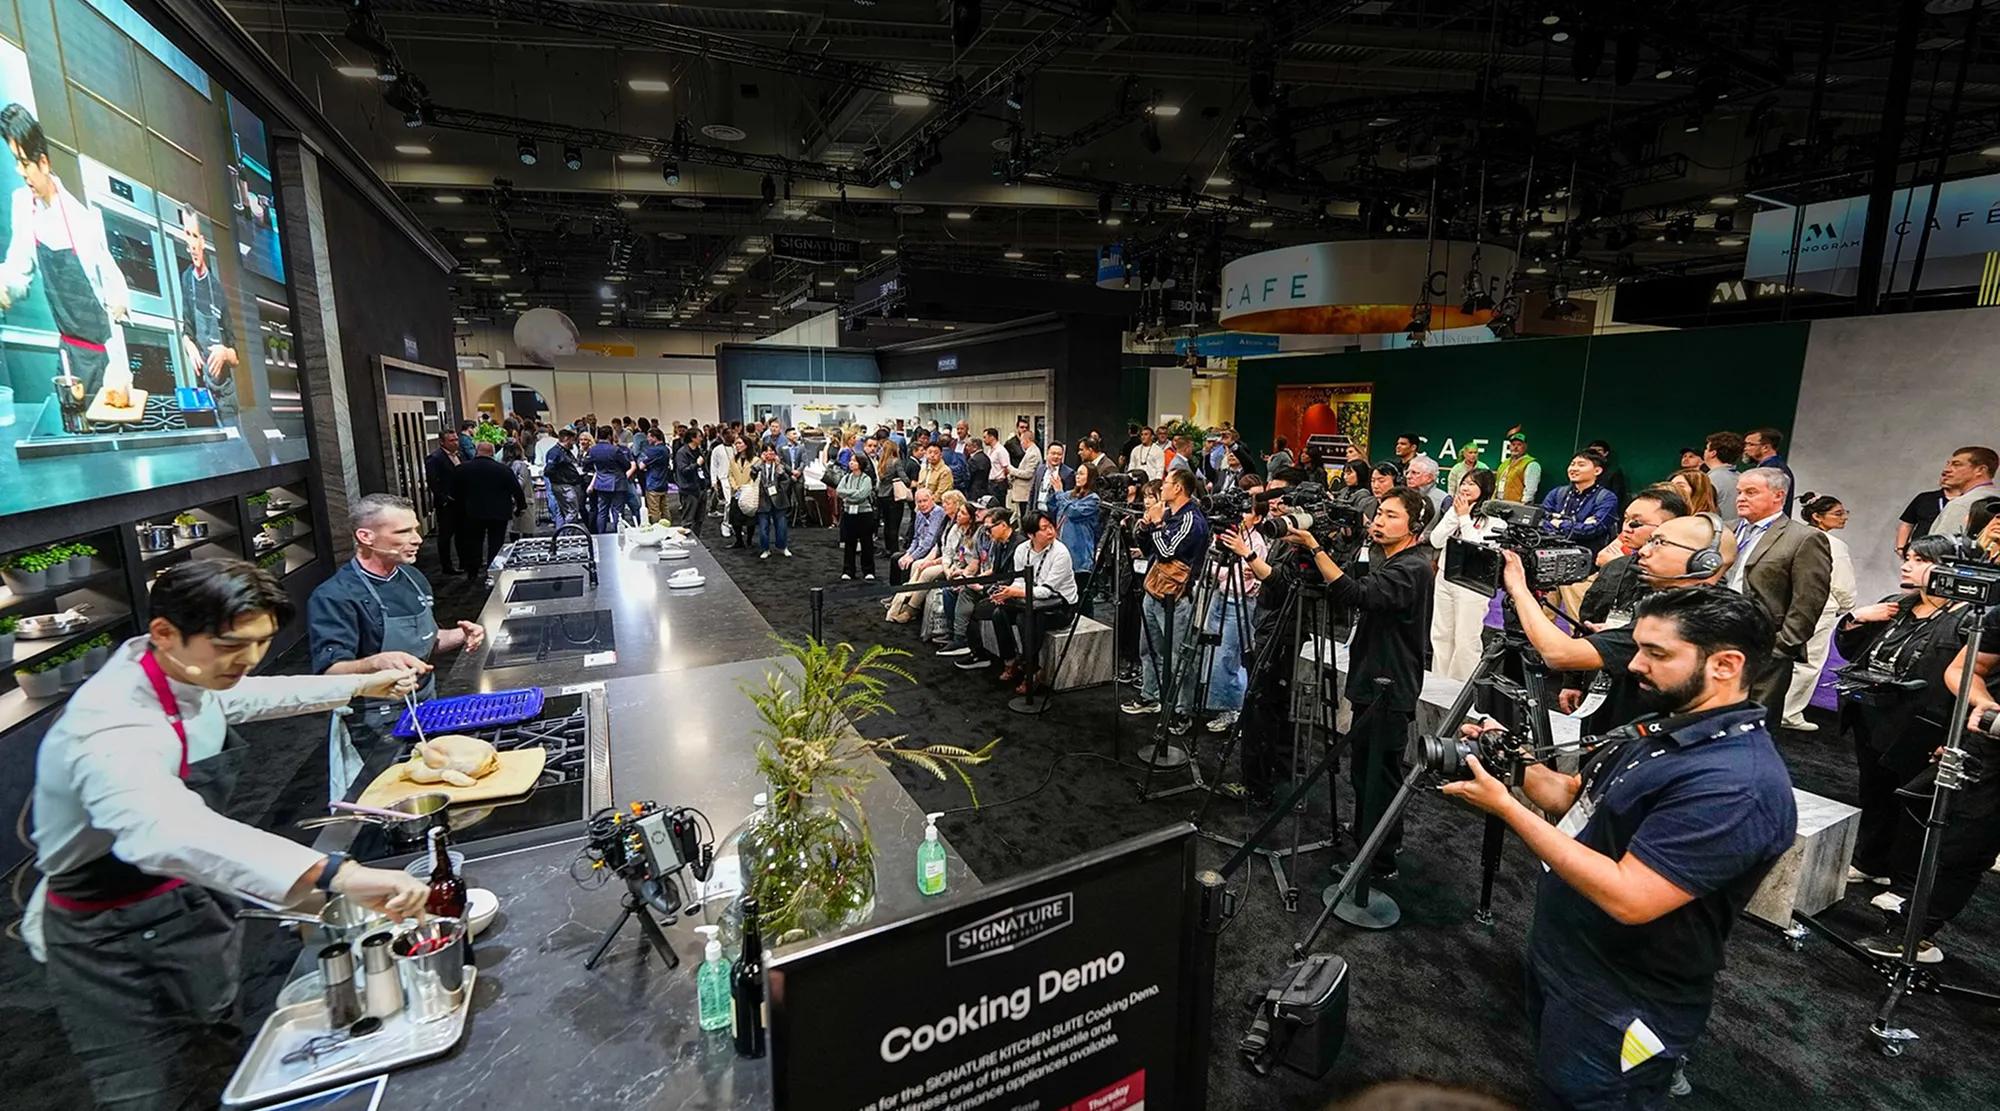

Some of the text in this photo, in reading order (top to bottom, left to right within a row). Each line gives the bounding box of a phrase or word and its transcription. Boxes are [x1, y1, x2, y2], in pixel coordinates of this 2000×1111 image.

[780, 236, 856, 252] SIGNATURE
[958, 900, 1063, 950] SIGNATURE
[880, 950, 1126, 1063] Cooking Demo
[878, 1094, 899, 1111] for
[901, 1084, 924, 1103] the
[925, 1051, 998, 1093] SIGNATURE
[999, 1028, 1051, 1062] KITCHEN
[1052, 1014, 1085, 1039] SUITE
[1085, 997, 1129, 1024] Cooking
[949, 1080, 974, 1100] one
[975, 1071, 989, 1088] of
[991, 1063, 1011, 1082] the
[1012, 1050, 1042, 1072] most
[1042, 1029, 1089, 1059] versatile
[1090, 1018, 1113, 1038] and
[943, 1084, 1004, 1111] formance
[1005, 1055, 1068, 1093] appliances
[1088, 1084, 1130, 1110] Thursday
